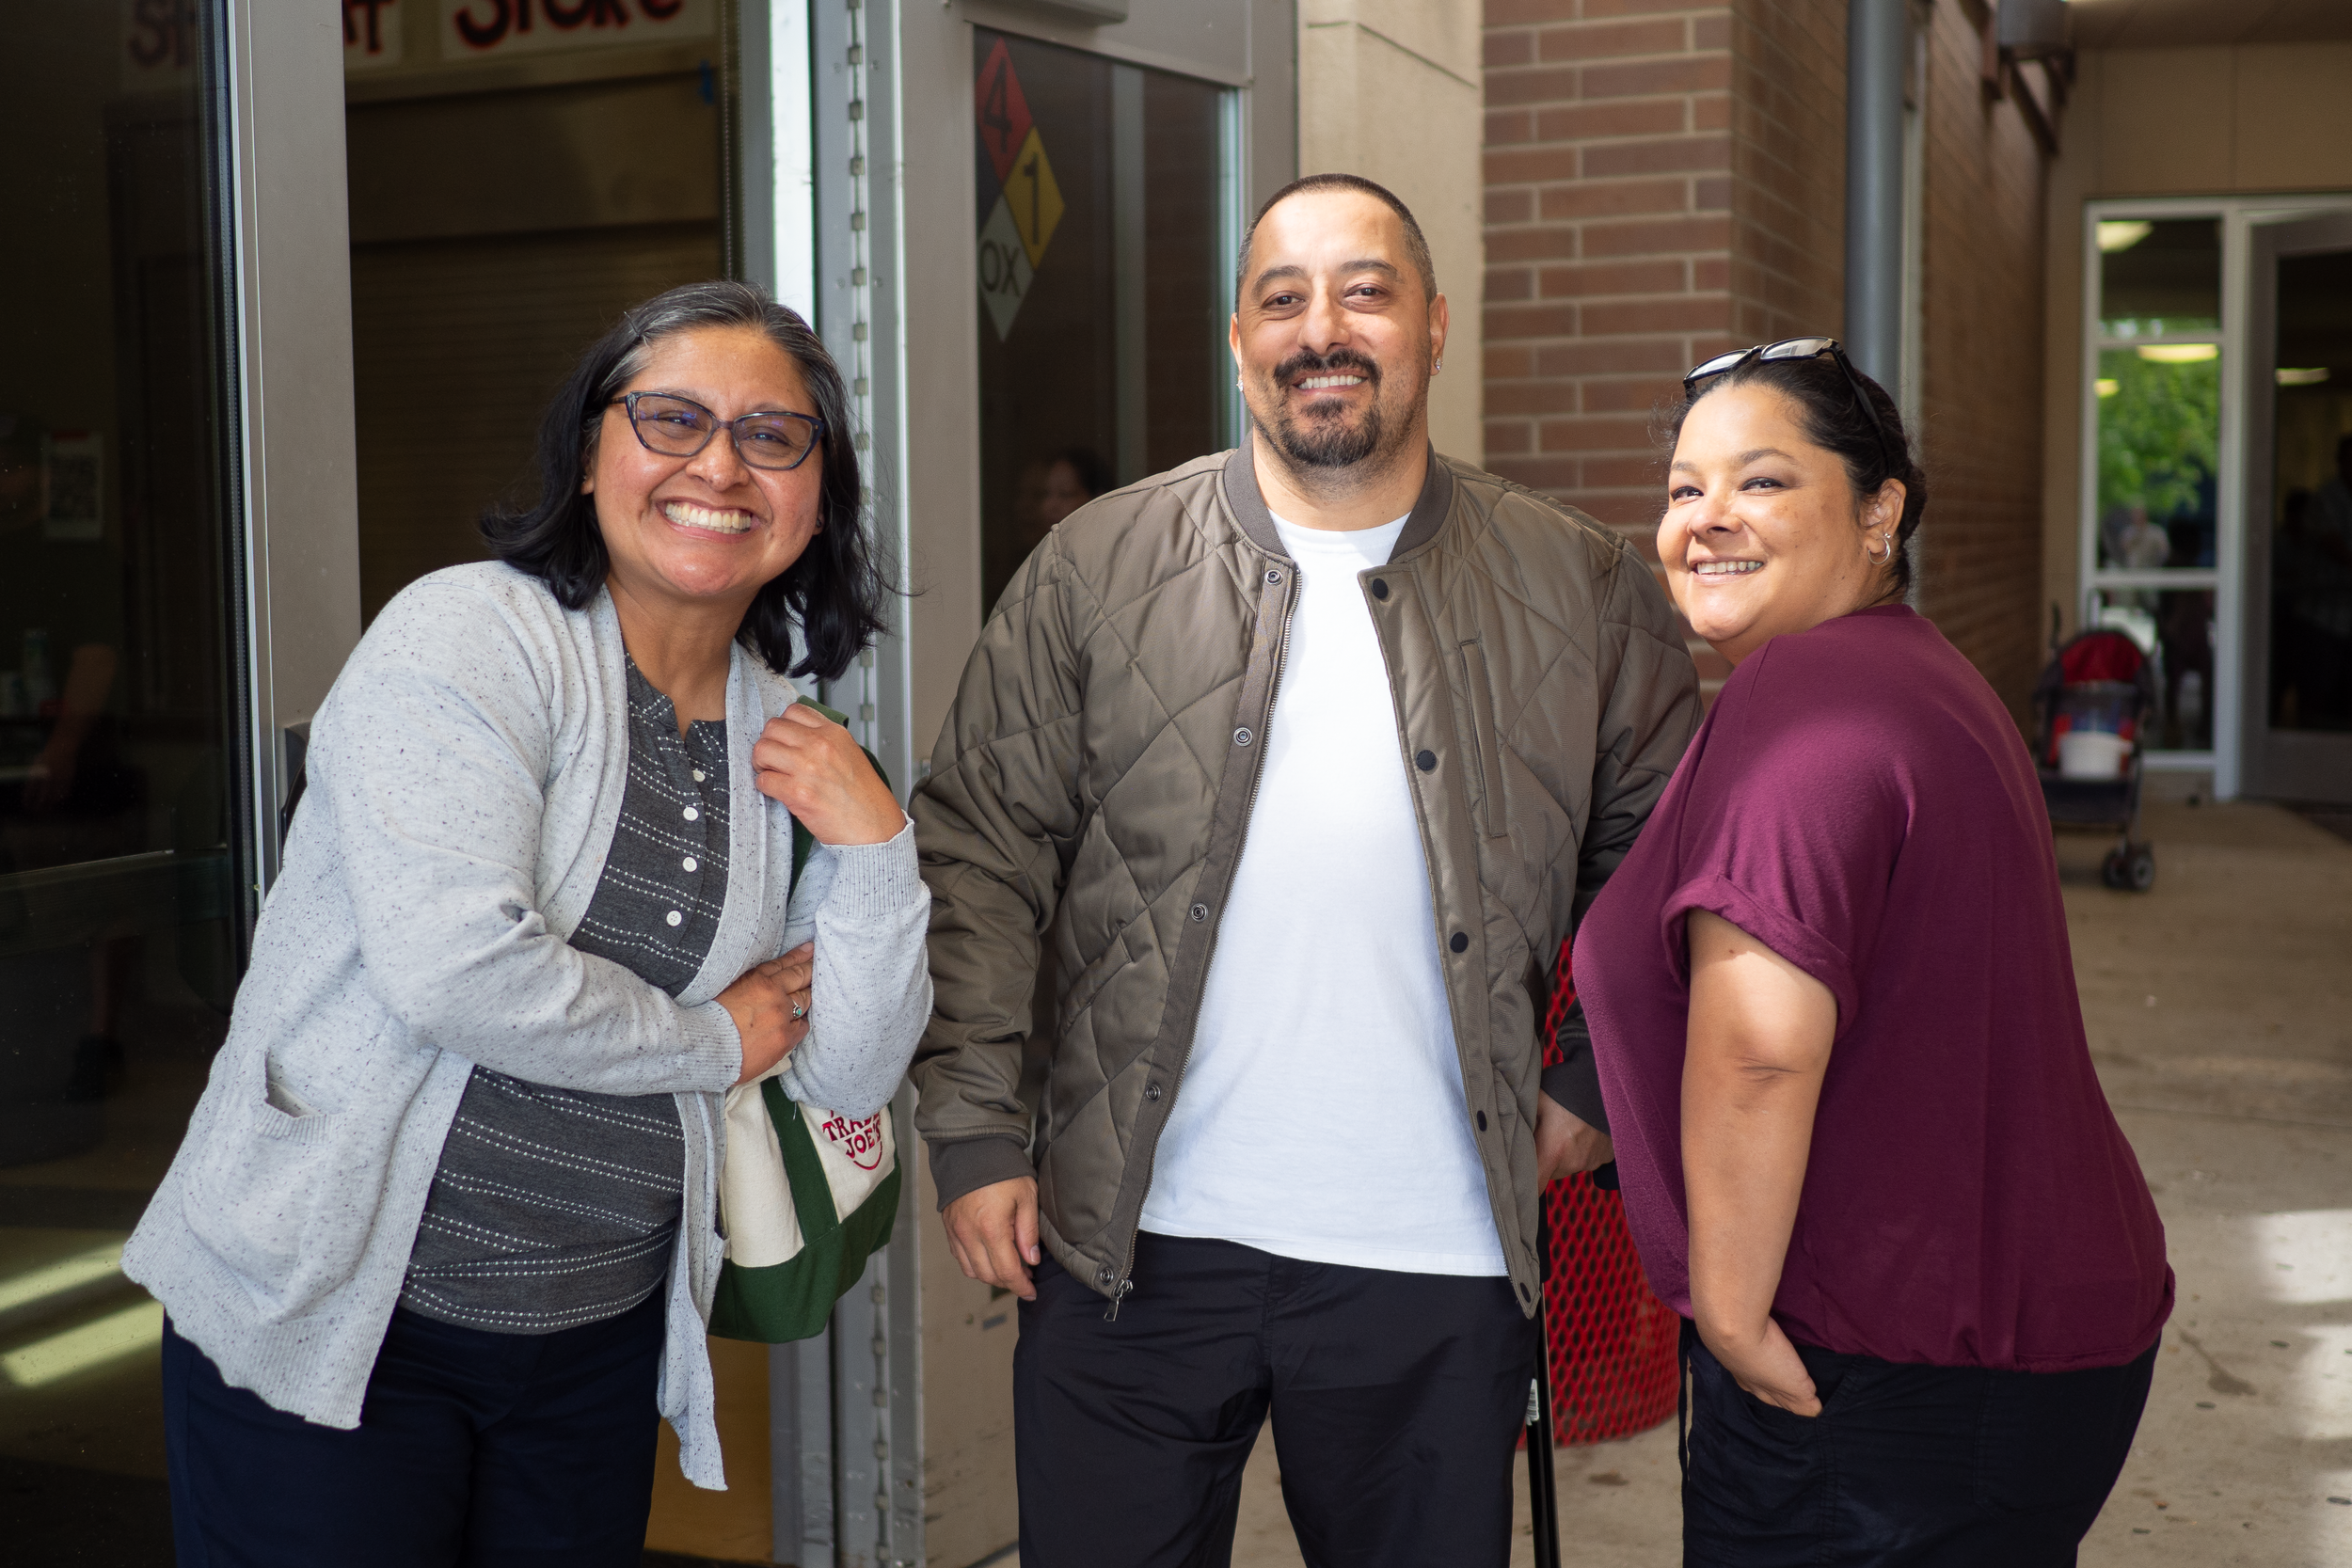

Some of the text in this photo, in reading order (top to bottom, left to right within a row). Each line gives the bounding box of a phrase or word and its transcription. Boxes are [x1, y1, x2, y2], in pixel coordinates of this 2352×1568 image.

[983, 56, 1013, 153] 4
[1023, 150, 1040, 246] 1
[979, 239, 1022, 298] OX
[845, 1119, 882, 1159] JOE'S
